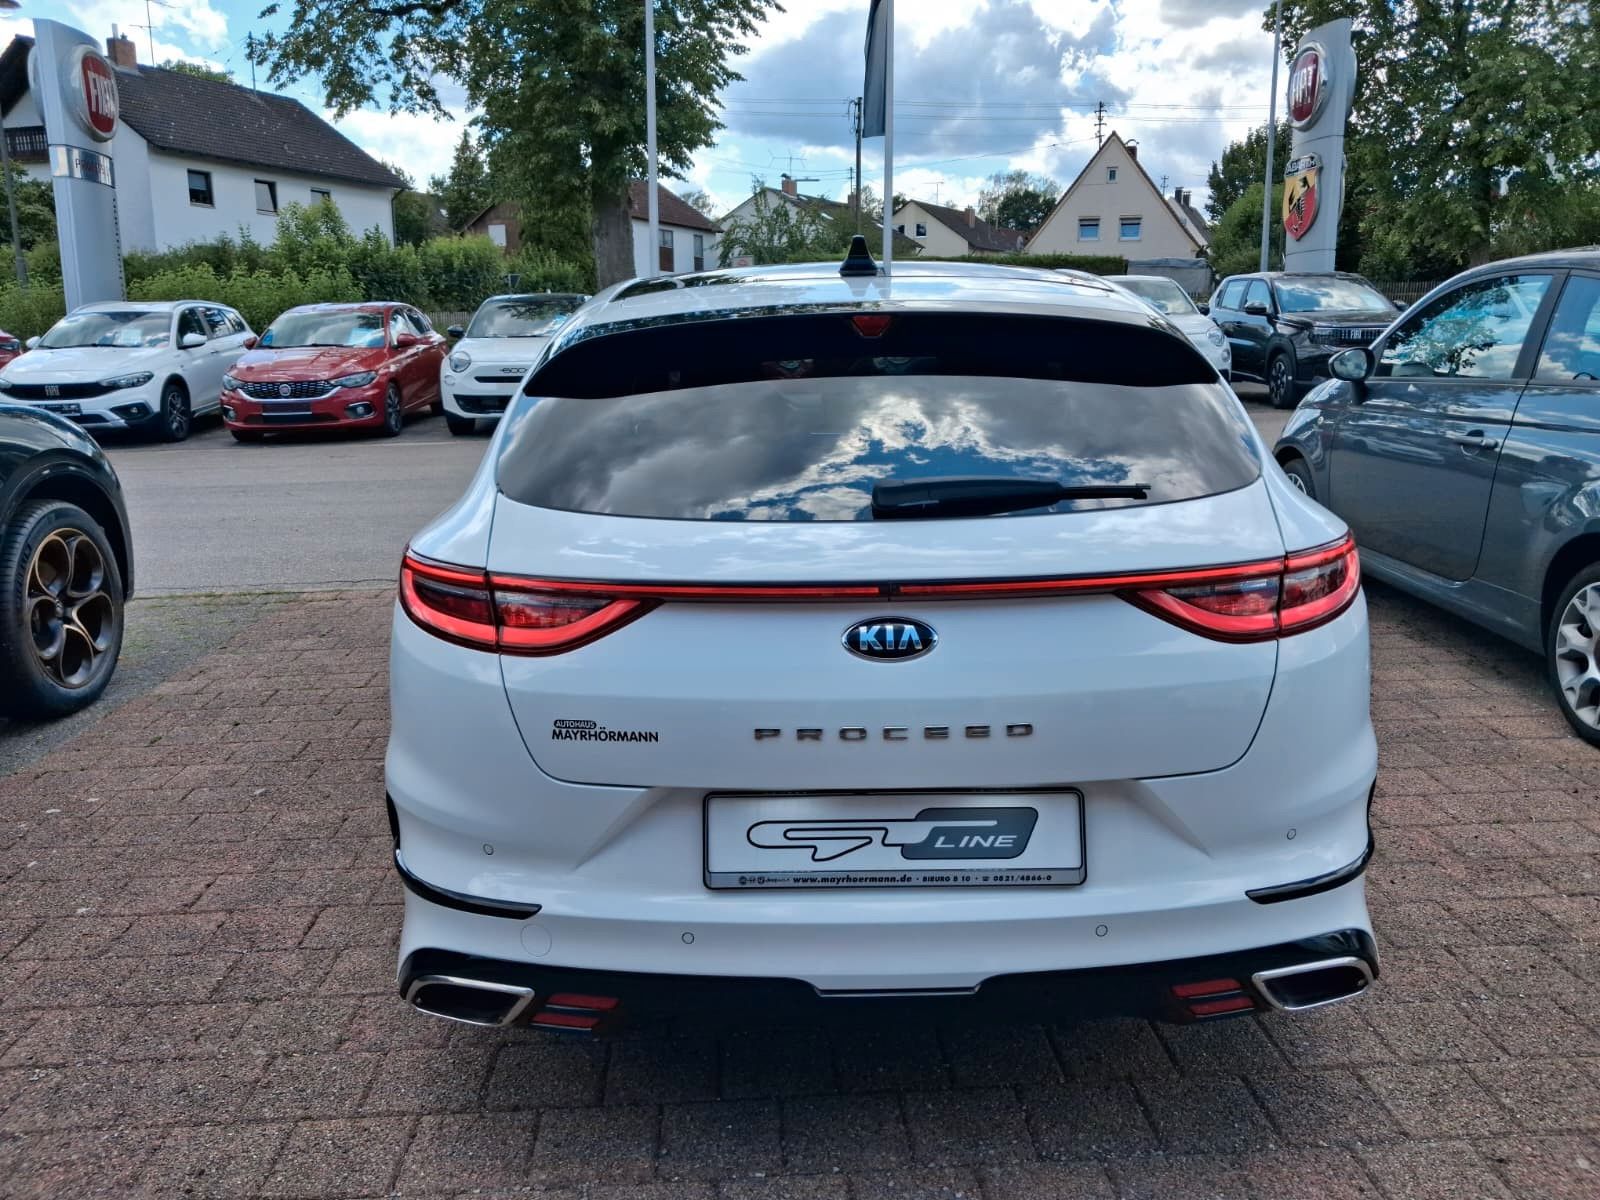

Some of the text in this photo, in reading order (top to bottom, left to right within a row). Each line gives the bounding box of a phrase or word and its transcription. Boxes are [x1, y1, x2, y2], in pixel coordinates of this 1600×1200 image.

[859, 624, 923, 650] KIA
[555, 720, 596, 729] AUTOHAUS
[552, 727, 659, 743] MAYRHÖRMANN
[754, 723, 1034, 742] PROCEED
[934, 835, 1017, 848] LINE
[793, 874, 912, 885] www.mayrhoermann.de
